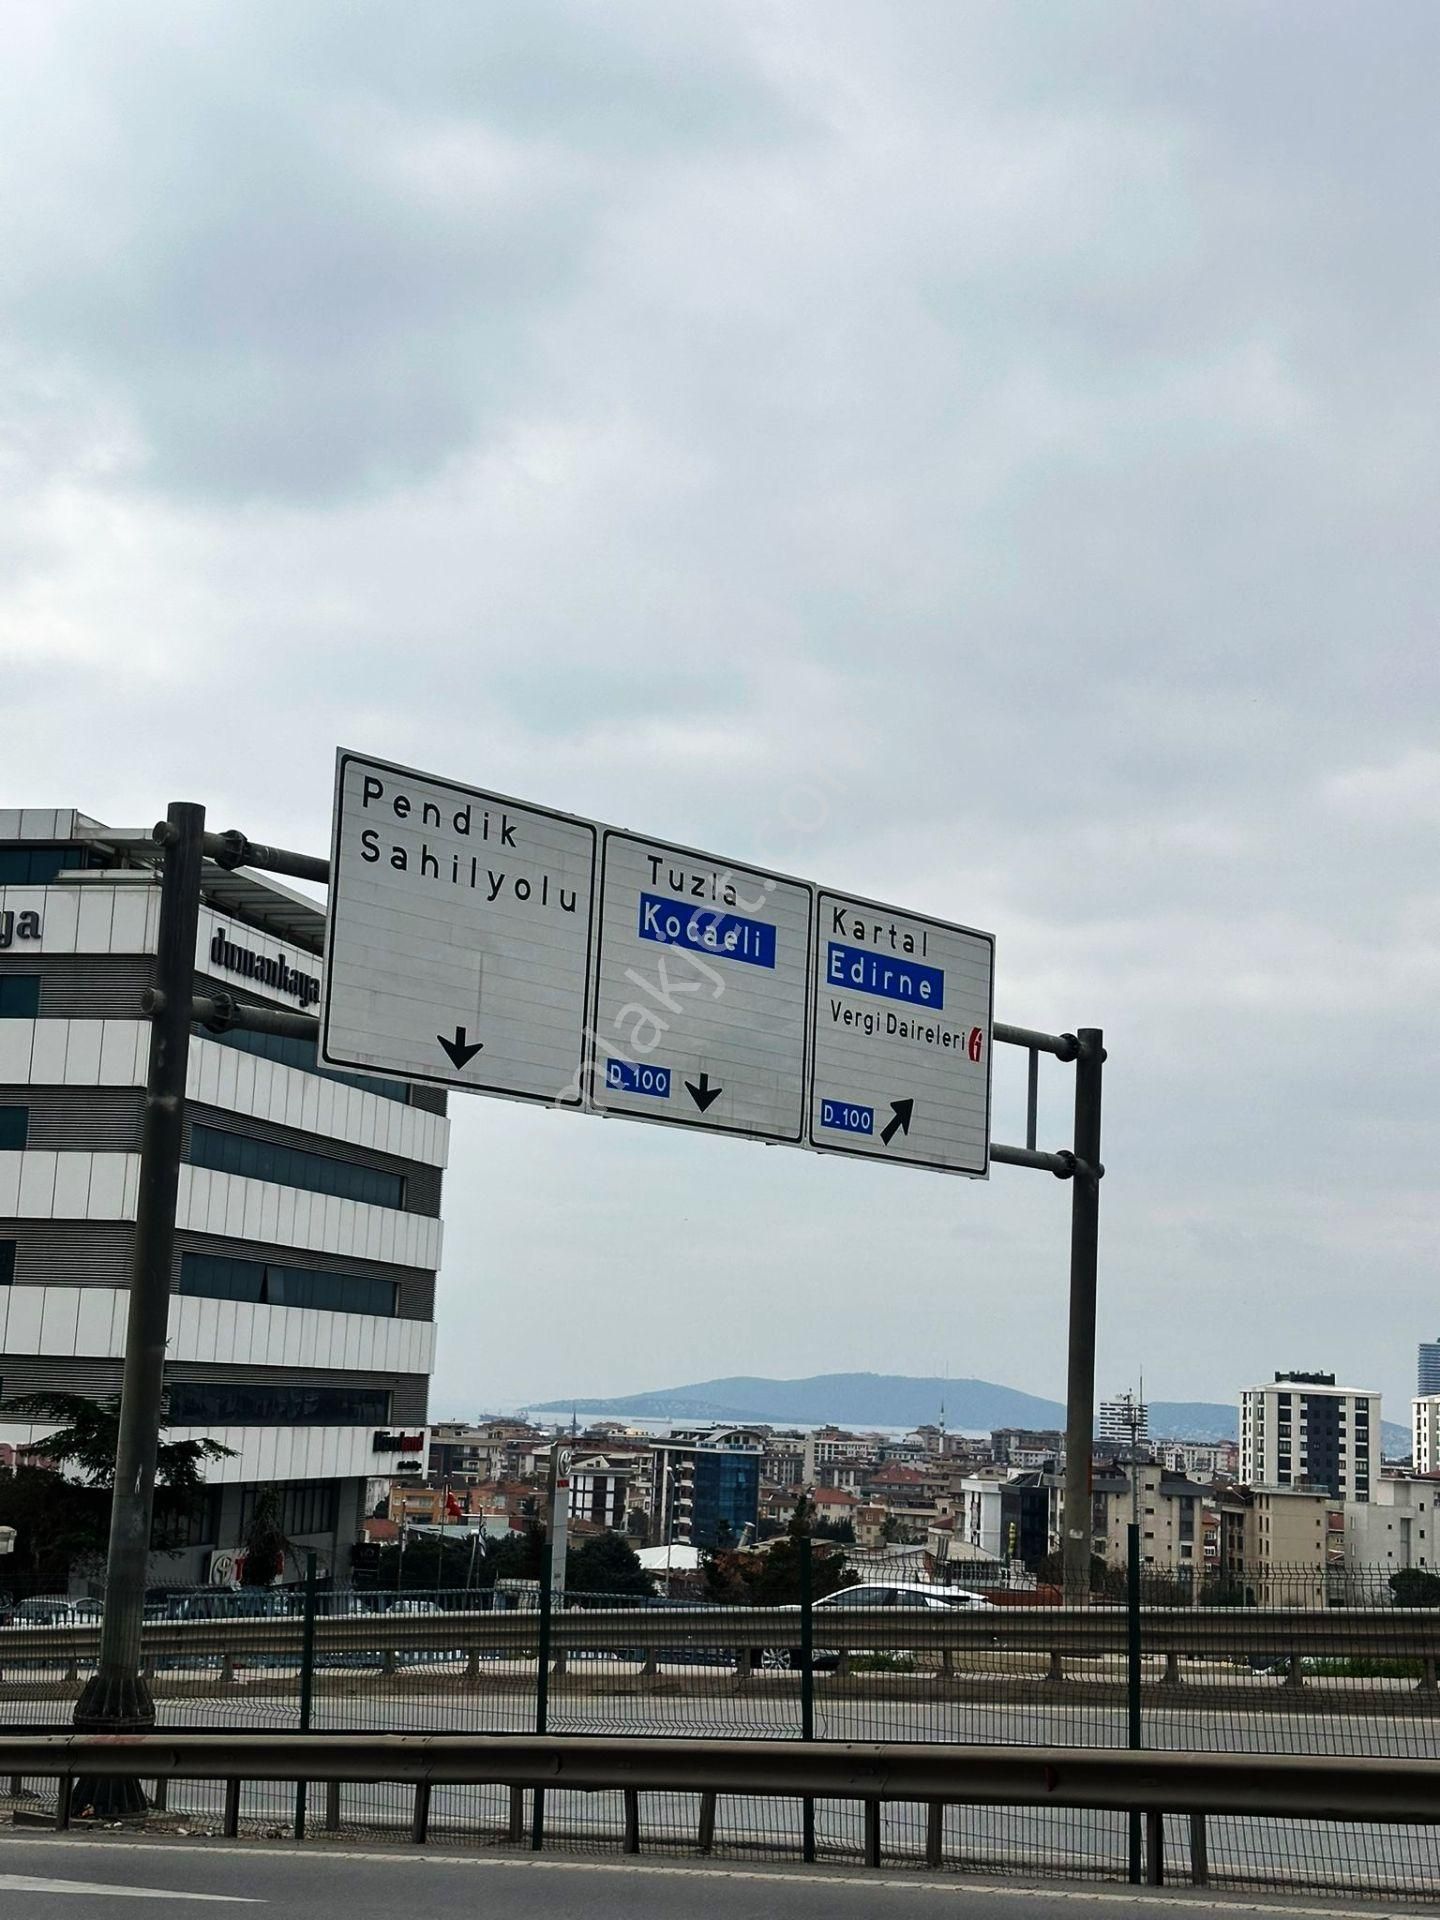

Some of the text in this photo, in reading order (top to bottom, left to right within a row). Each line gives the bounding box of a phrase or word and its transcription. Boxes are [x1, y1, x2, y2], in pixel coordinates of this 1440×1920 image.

[361, 775, 517, 848] Pendik
[360, 829, 577, 913] Sahilyolu
[647, 855, 737, 906] Tuzla
[644, 901, 760, 957] Kocaeli
[832, 906, 928, 957] Kartal
[211, 926, 320, 1007] dumankaya
[831, 951, 932, 1000] Edirne
[830, 999, 966, 1051] Vergi Daireleri
